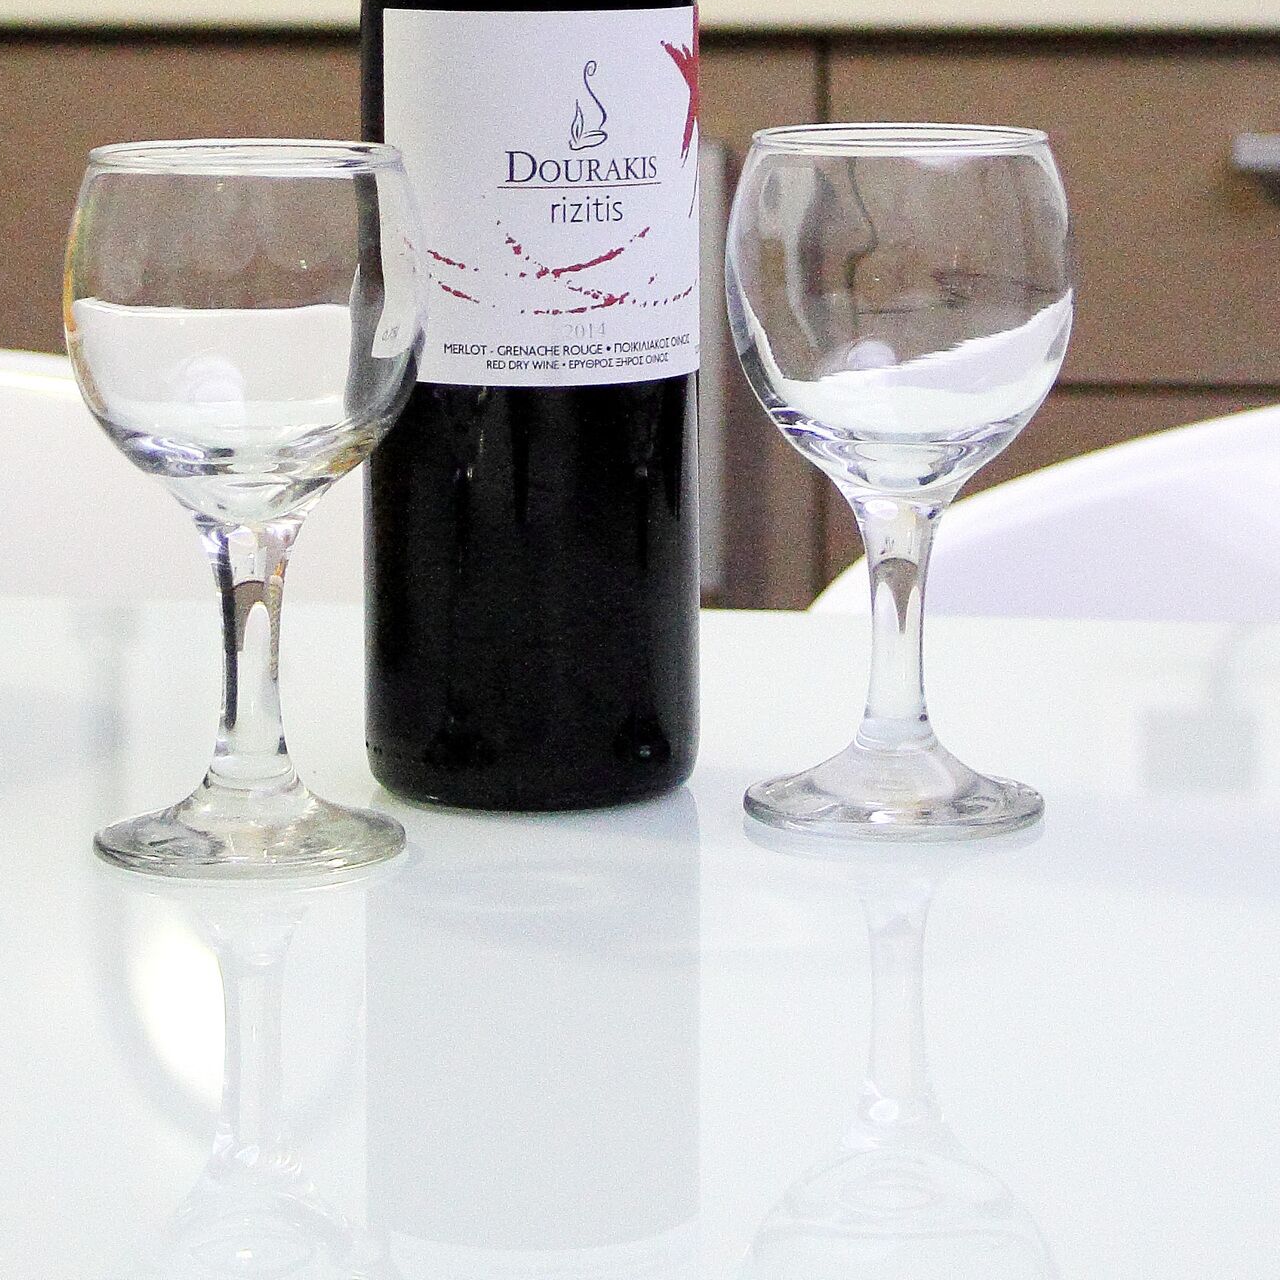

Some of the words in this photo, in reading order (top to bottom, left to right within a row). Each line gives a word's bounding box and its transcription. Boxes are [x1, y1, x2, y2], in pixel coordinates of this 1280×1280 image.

[505, 150, 658, 183] DOURAKIS
[551, 195, 624, 223] rizitis
[564, 322, 605, 339] 2014
[443, 343, 488, 355] MERLOT
[497, 345, 560, 356] GRENACHE
[563, 344, 603, 356] ROUGE
[486, 360, 506, 370] RED
[508, 360, 530, 370] DRY
[532, 360, 560, 370] WINE
